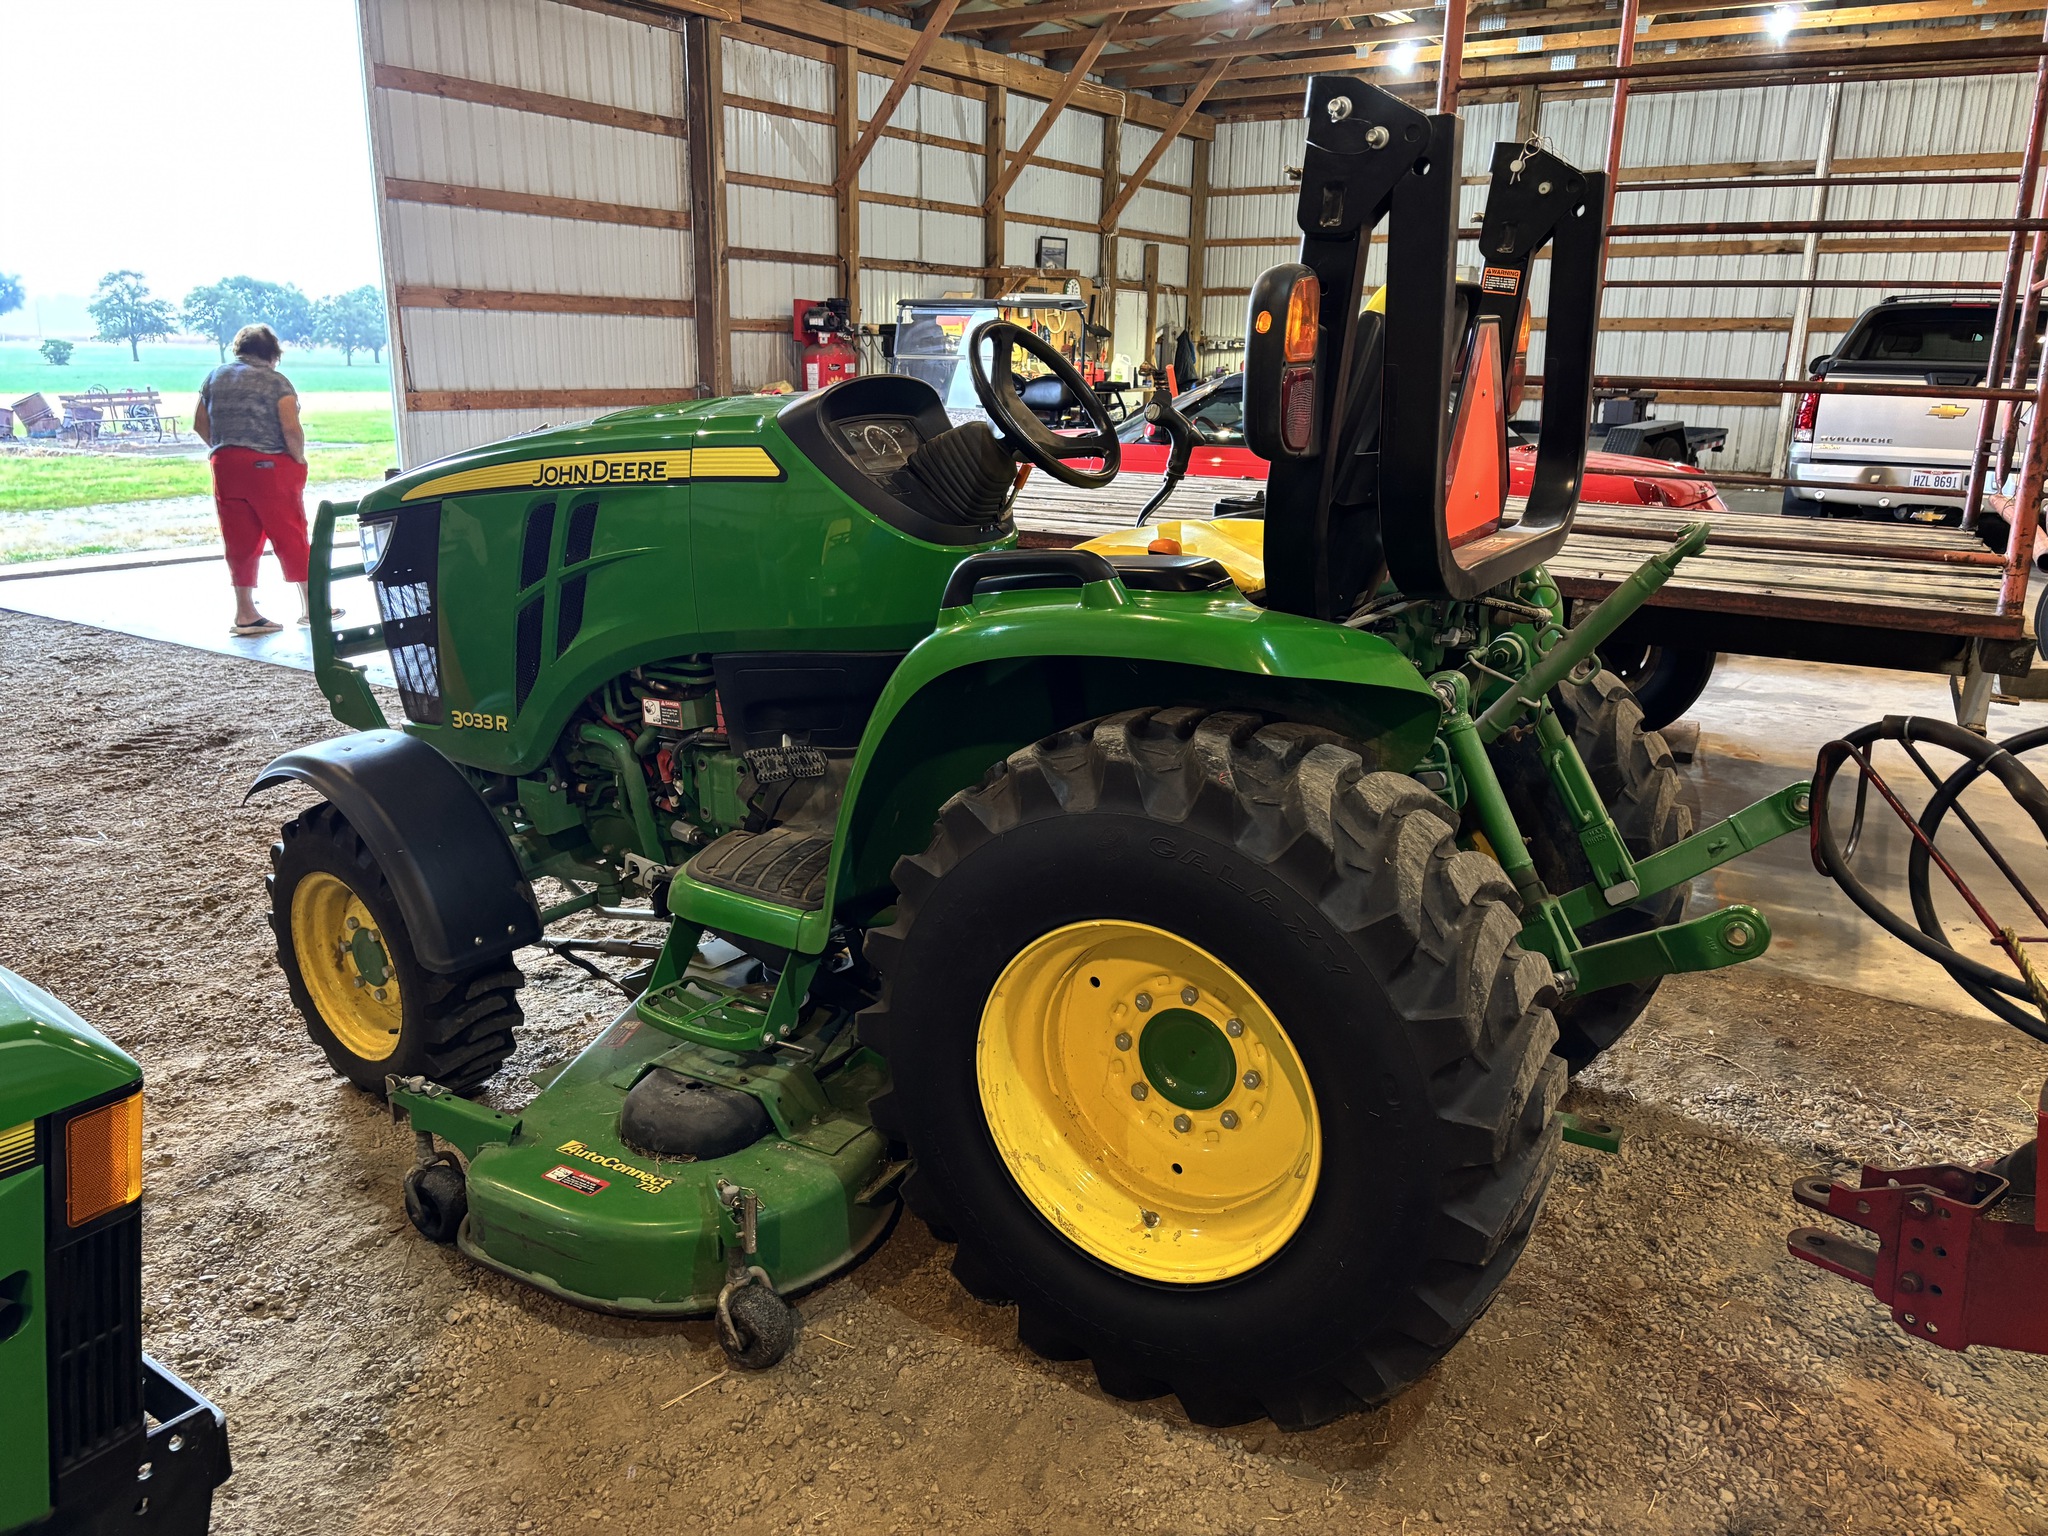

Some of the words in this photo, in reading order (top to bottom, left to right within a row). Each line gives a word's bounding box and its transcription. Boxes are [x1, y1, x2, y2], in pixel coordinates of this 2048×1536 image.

[1820, 436, 1893, 444] AVALANCHE
[532, 464, 589, 485] JOHN
[592, 460, 667, 482] DEERE
[1913, 475, 1930, 487] HZL
[1933, 476, 1957, 488] 8691
[558, 1141, 674, 1188] AutoConnect
[634, 1181, 663, 1194] 72D
